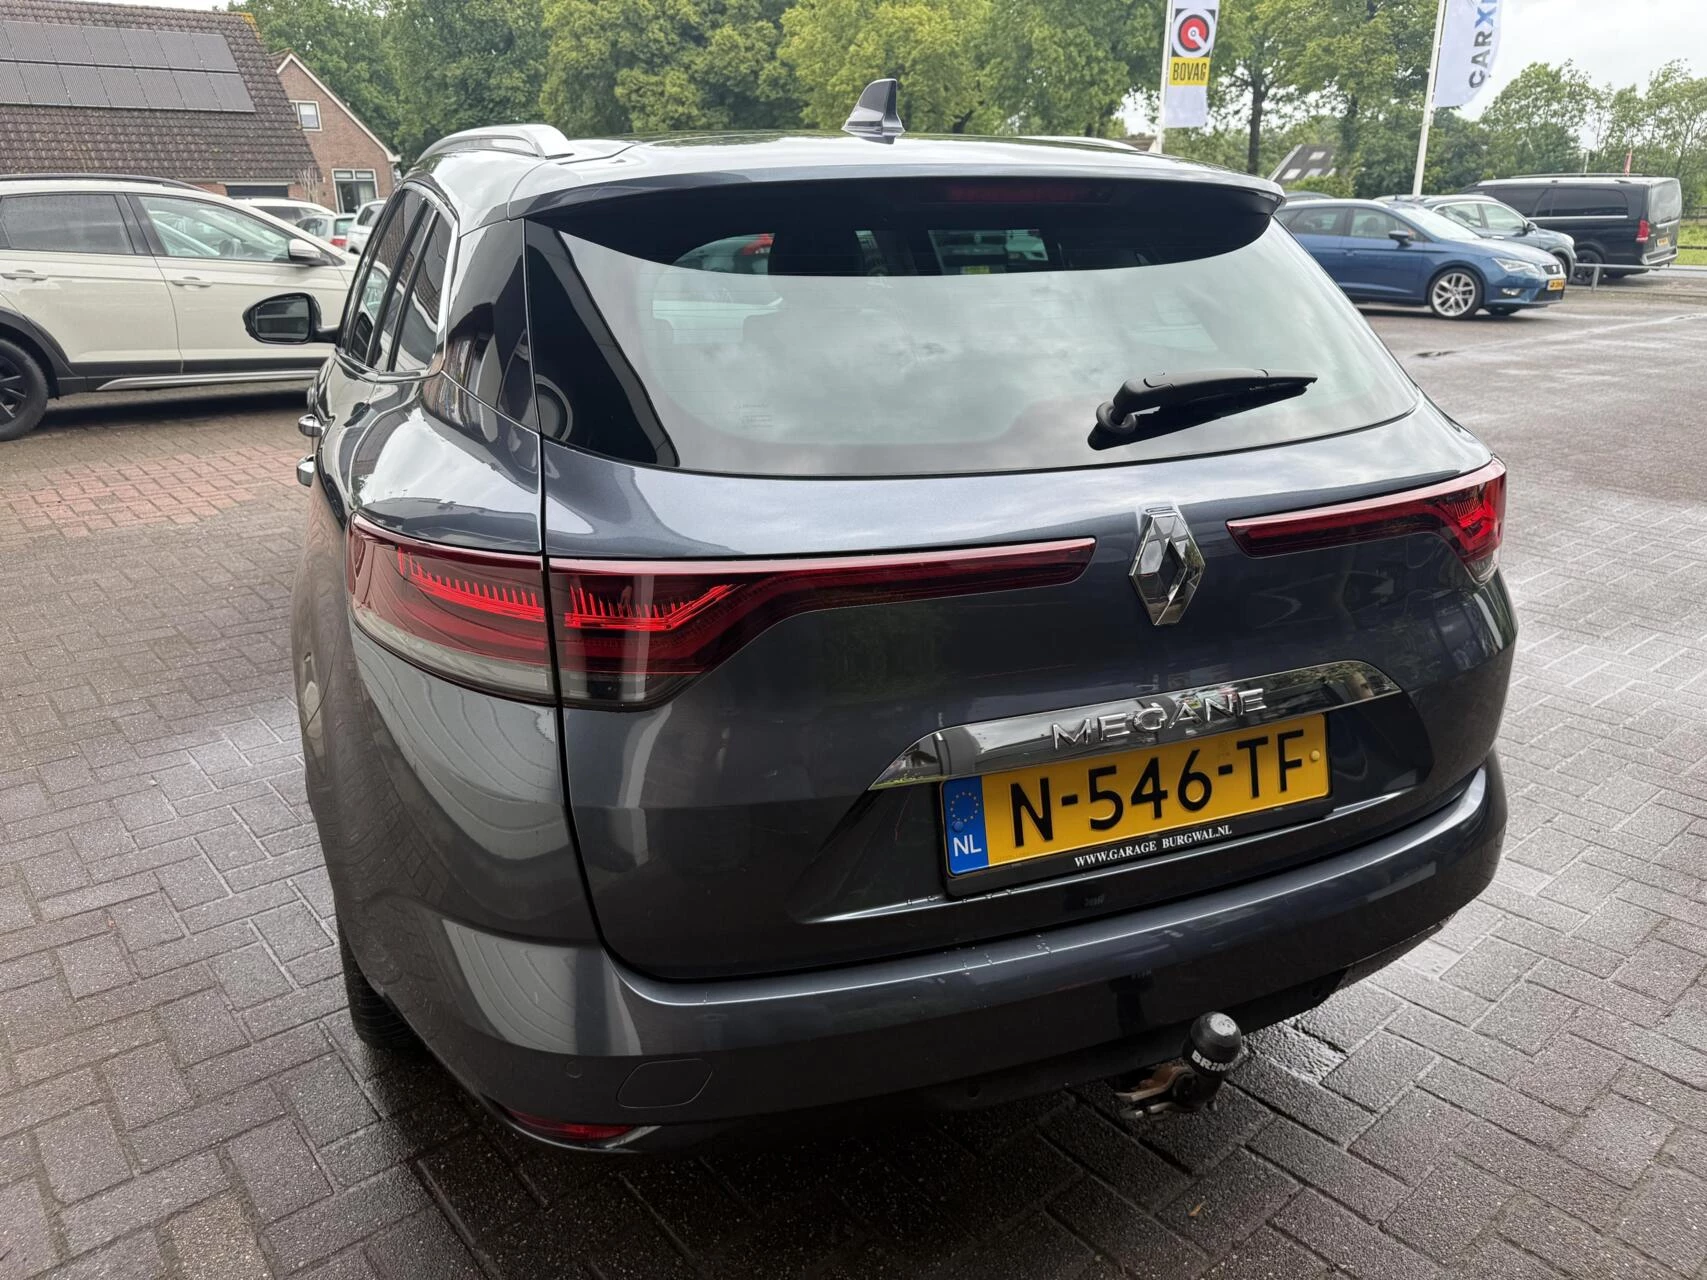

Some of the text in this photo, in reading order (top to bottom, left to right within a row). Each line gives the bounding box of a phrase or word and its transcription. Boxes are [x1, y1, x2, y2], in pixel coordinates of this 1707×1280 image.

[1468, 0, 1498, 89] CARX
[1172, 62, 1207, 81] BOVAG
[1051, 688, 1266, 750] MEGANE
[1010, 729, 1304, 848] N-546-TF
[953, 834, 982, 857] NL
[1073, 824, 1233, 868] WWW.GARAGE BURGWAL.NL
